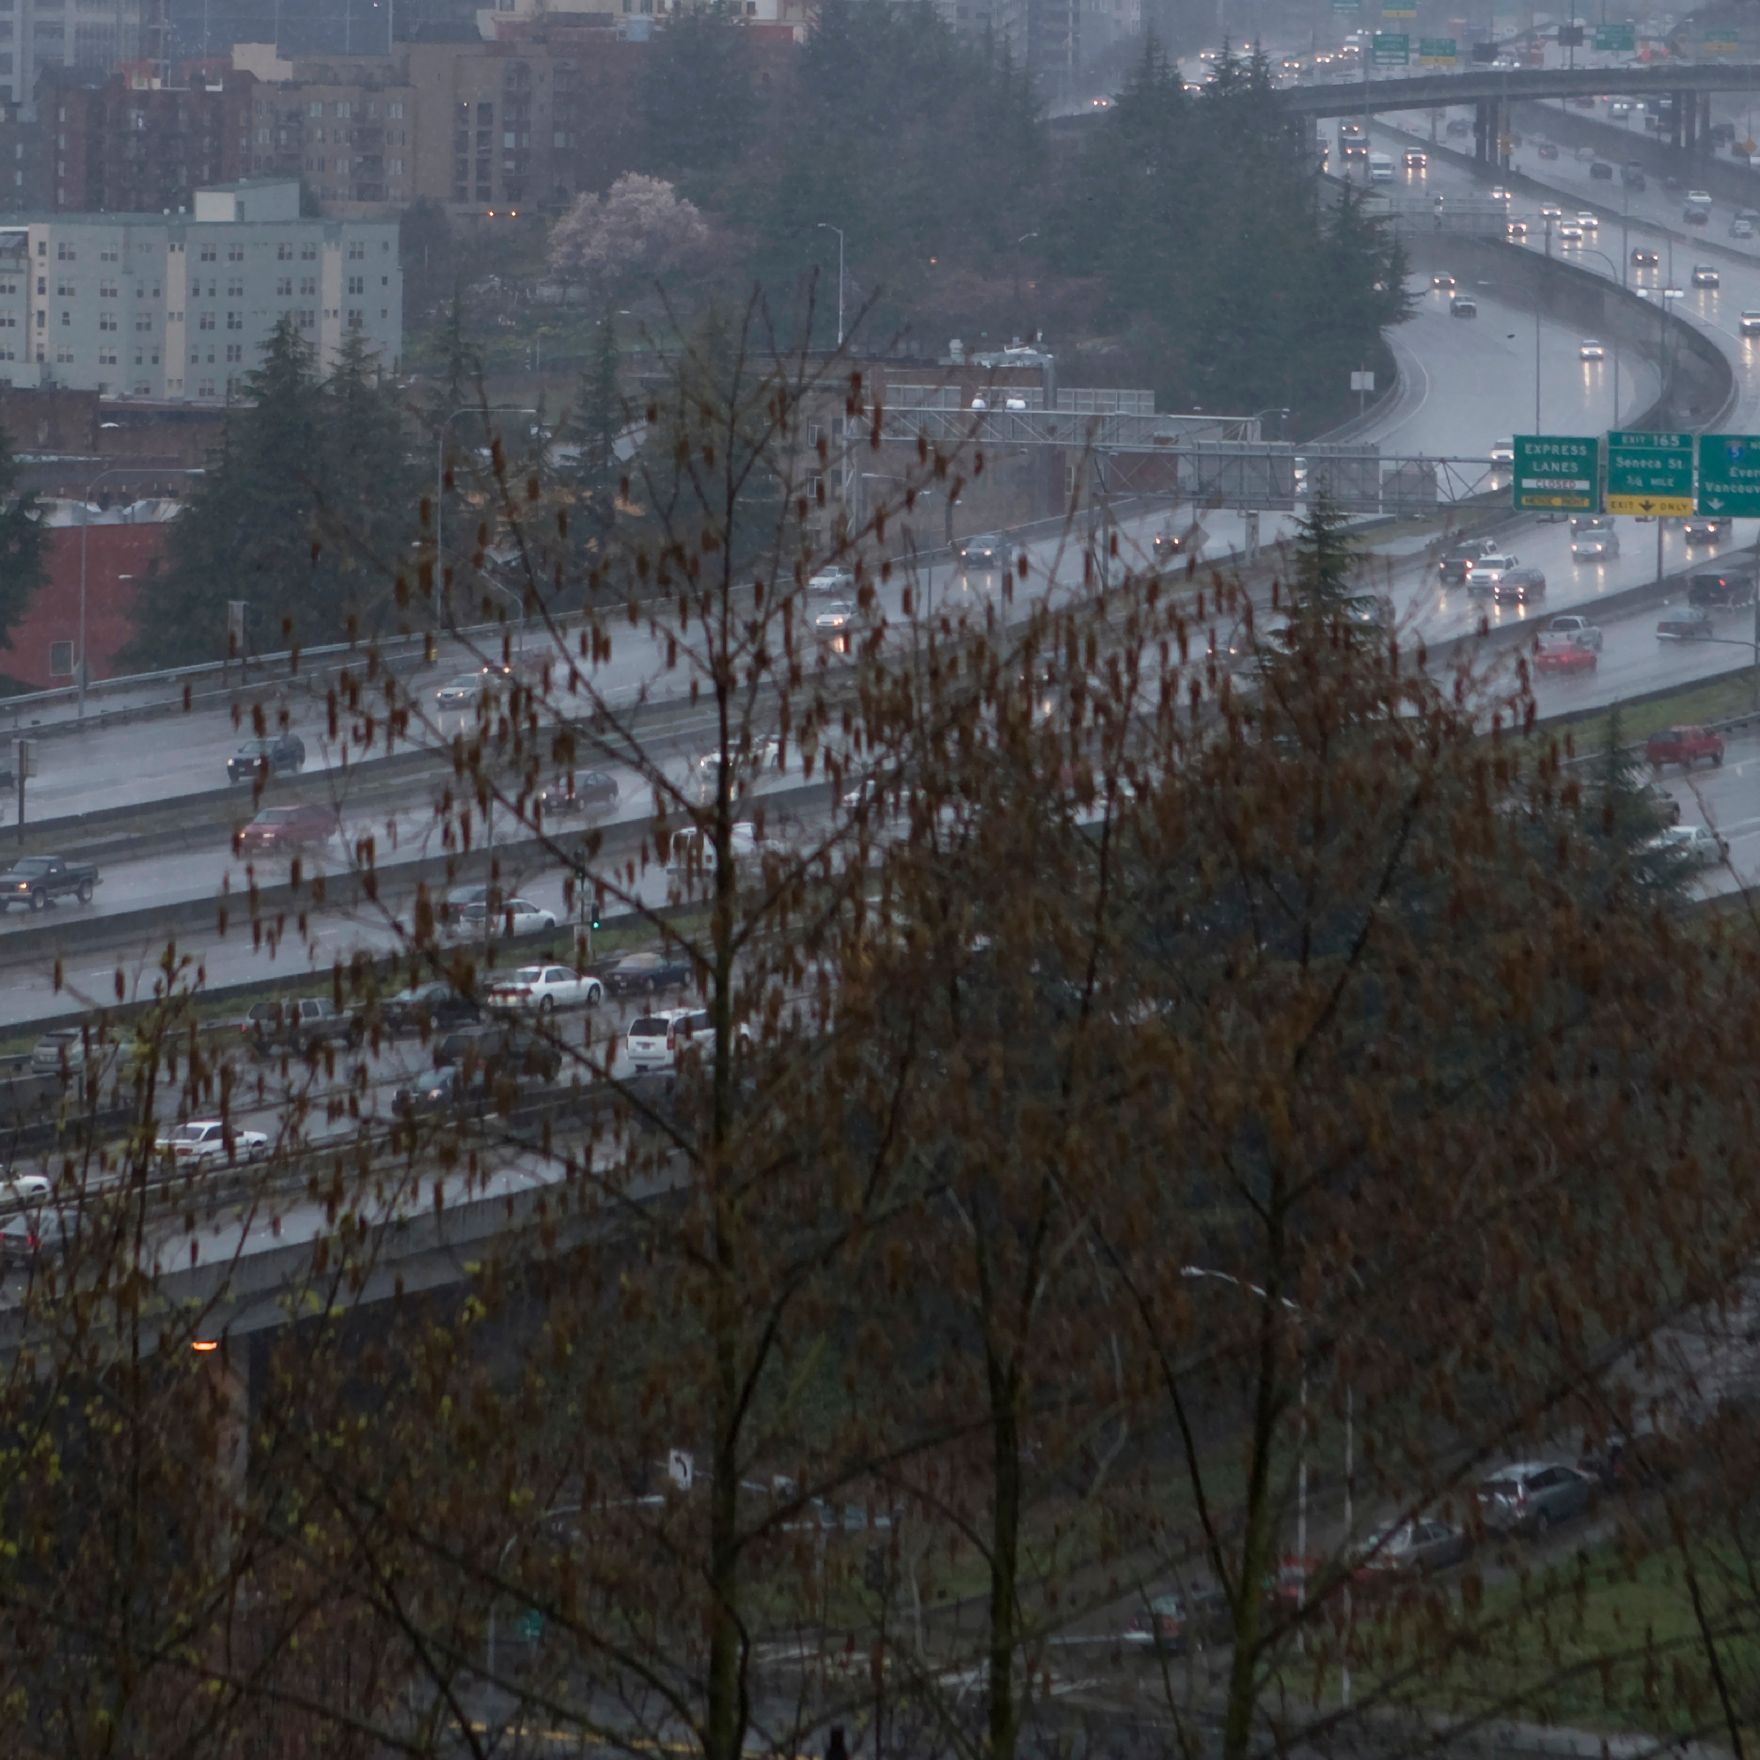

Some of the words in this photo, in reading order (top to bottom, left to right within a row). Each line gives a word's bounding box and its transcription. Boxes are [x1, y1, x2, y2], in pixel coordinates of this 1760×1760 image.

[1622, 434, 1645, 444] EXIT
[1653, 435, 1680, 447] 165
[1524, 444, 1588, 456] EXPRESS
[1532, 461, 1579, 473] LANES
[1615, 456, 1662, 469] Seneca
[1536, 479, 1577, 489] CLOSED
[1650, 477, 1674, 487] MILE
[1611, 500, 1634, 509] EXIT
[1660, 502, 1688, 512] ONLY
